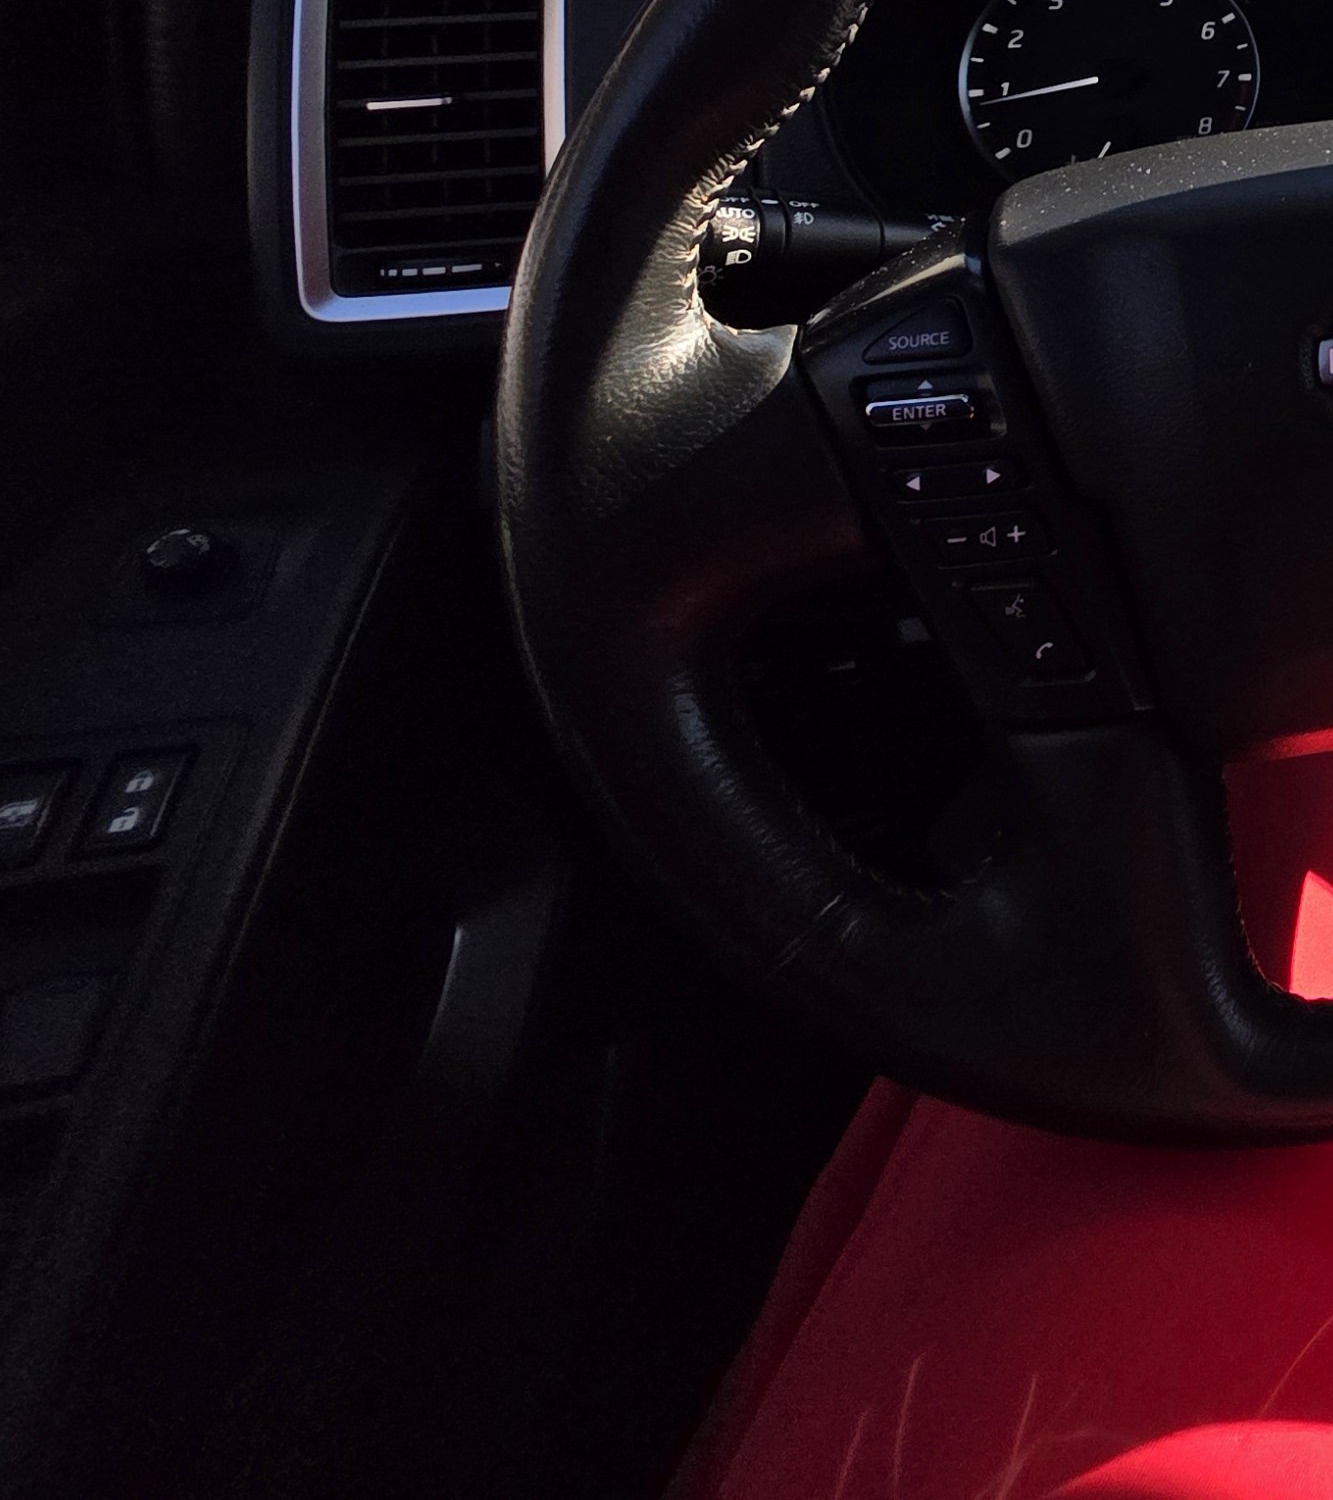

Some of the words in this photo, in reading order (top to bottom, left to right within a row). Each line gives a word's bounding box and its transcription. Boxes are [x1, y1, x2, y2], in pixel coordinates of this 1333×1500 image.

[1007, 29, 1025, 50] 2
[1200, 21, 1216, 41] 6
[1000, 81, 1011, 97] 1
[1217, 70, 1231, 89] 7
[1199, 116, 1213, 135] 8
[1016, 128, 1033, 149] 0
[888, 331, 950, 351] SOURCE
[892, 404, 947, 421] ENTER
